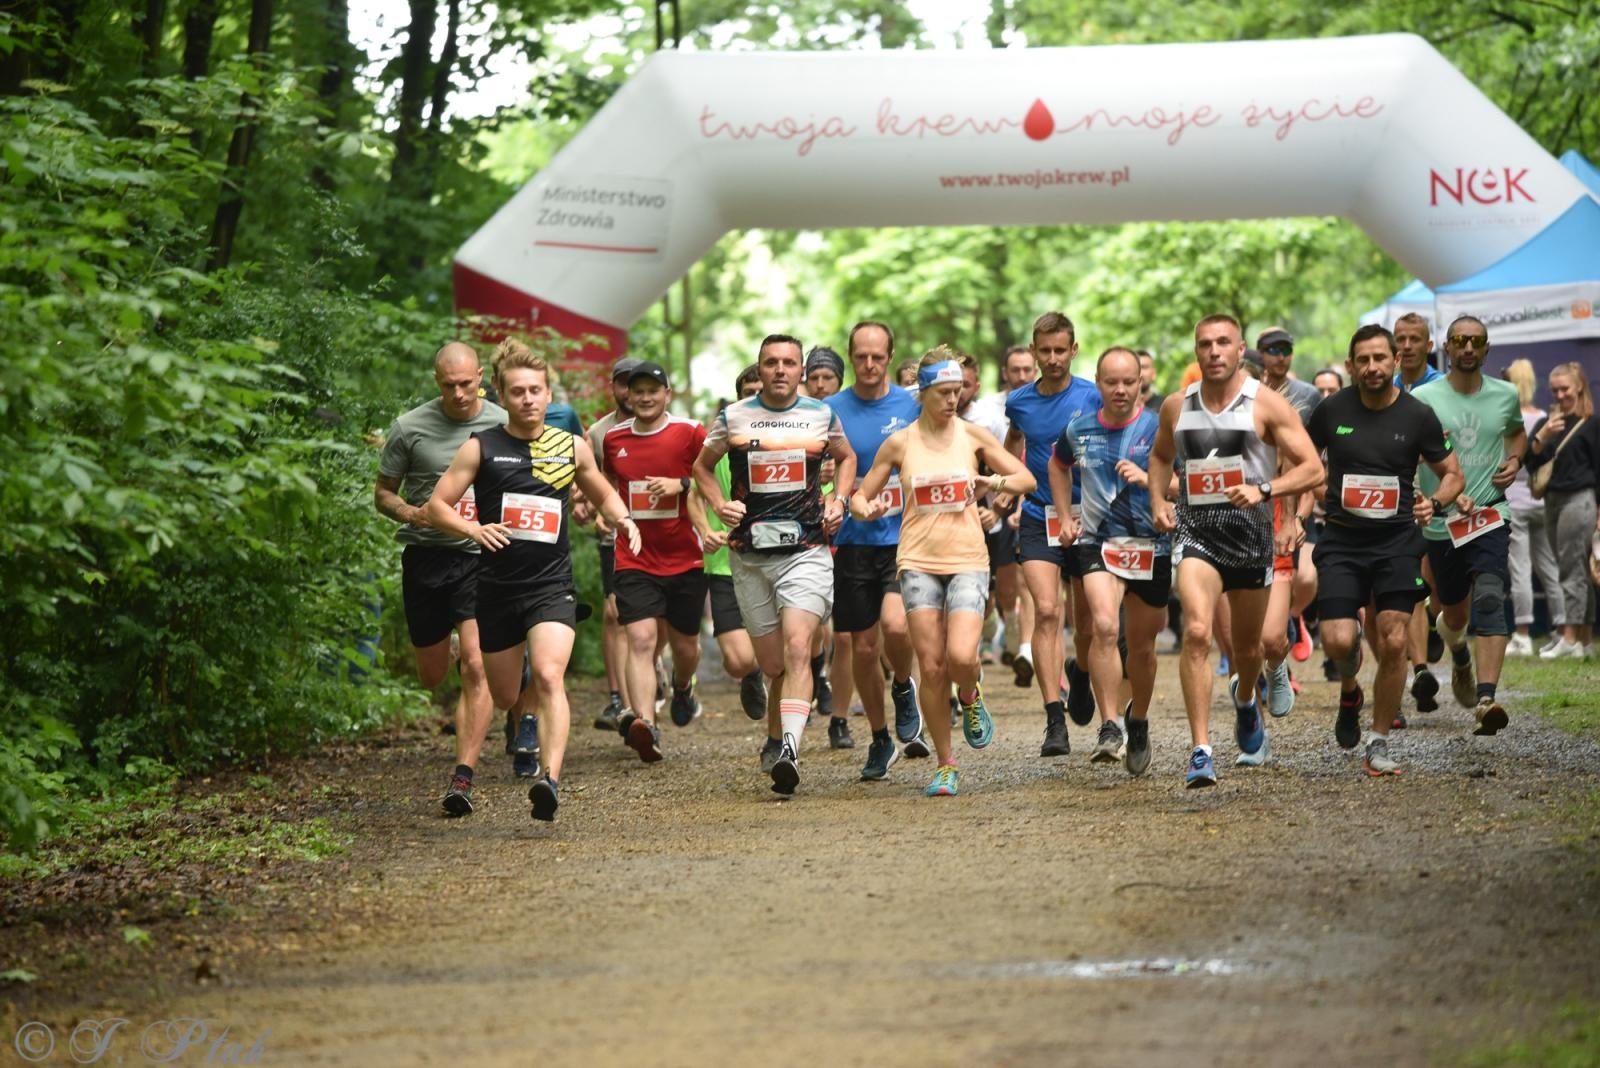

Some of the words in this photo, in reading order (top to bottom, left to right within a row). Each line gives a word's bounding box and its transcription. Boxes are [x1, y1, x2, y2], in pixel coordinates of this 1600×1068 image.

[699, 104, 857, 156] twoja
[875, 97, 1021, 139] krew
[1056, 102, 1222, 145] moje
[1242, 95, 1384, 140] życie
[940, 166, 1130, 189] www.twojakrew.pl
[1430, 167, 1535, 206] NCK
[543, 185, 665, 208] Ministerstwo
[536, 208, 614, 229] Zdrowia
[765, 465, 790, 483] 22
[1202, 473, 1225, 493] 31
[648, 494, 660, 510] 9
[931, 485, 956, 503] 83
[1359, 489, 1385, 508] 72
[518, 510, 545, 530] 55
[1461, 513, 1487, 534] 76
[1118, 551, 1141, 569] 32
